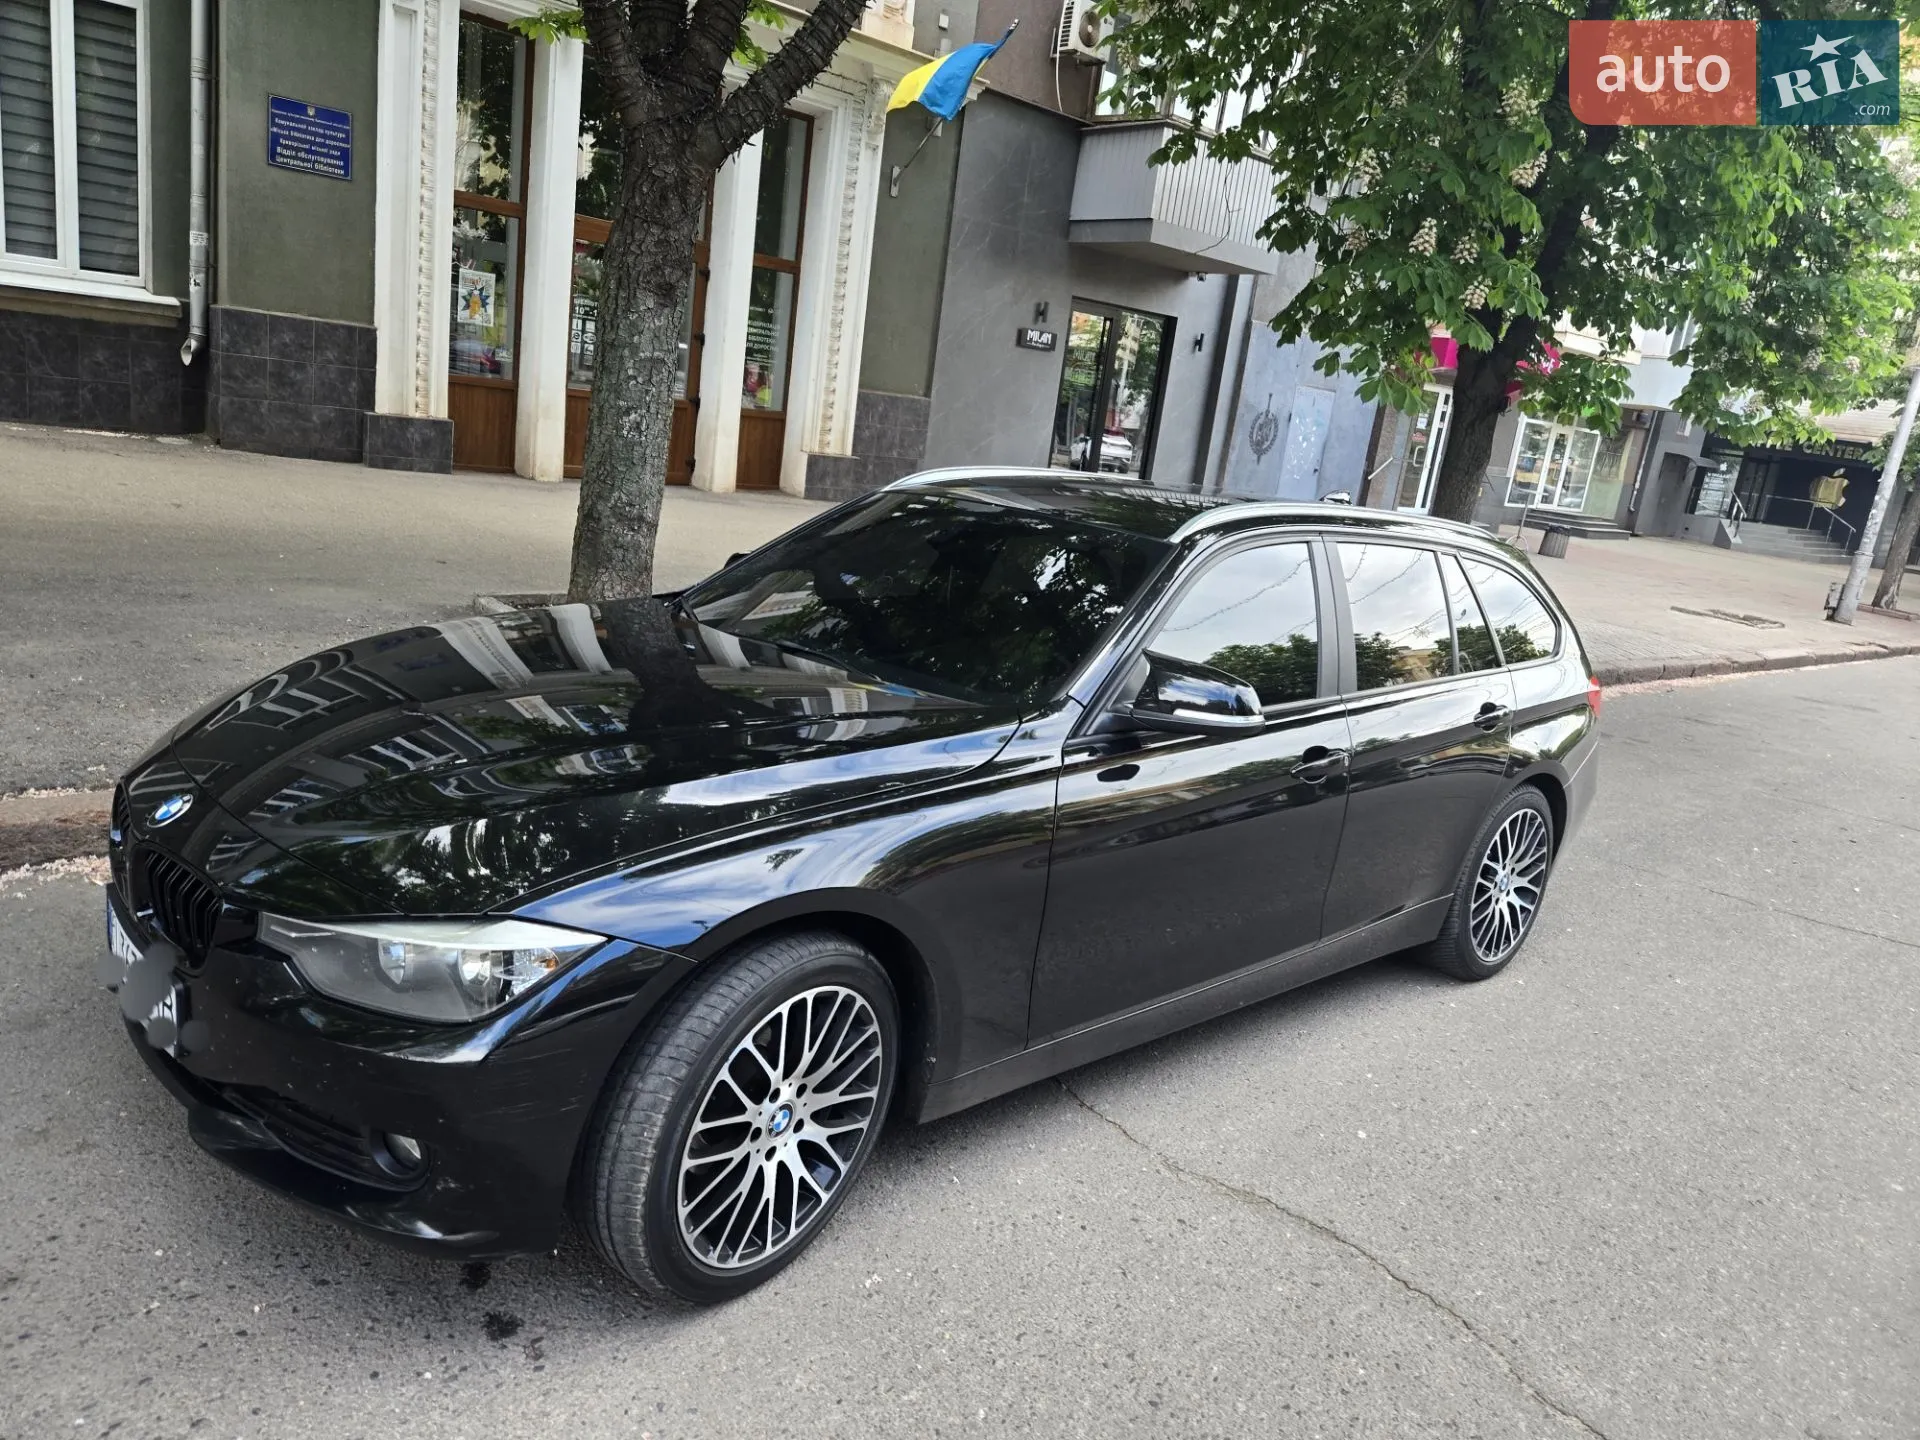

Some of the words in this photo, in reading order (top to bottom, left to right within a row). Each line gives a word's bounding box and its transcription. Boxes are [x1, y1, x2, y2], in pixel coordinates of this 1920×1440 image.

[276, 146, 296, 157] Відділ
[314, 163, 345, 175] бібліотеки
[1802, 441, 1864, 460] CENTER
